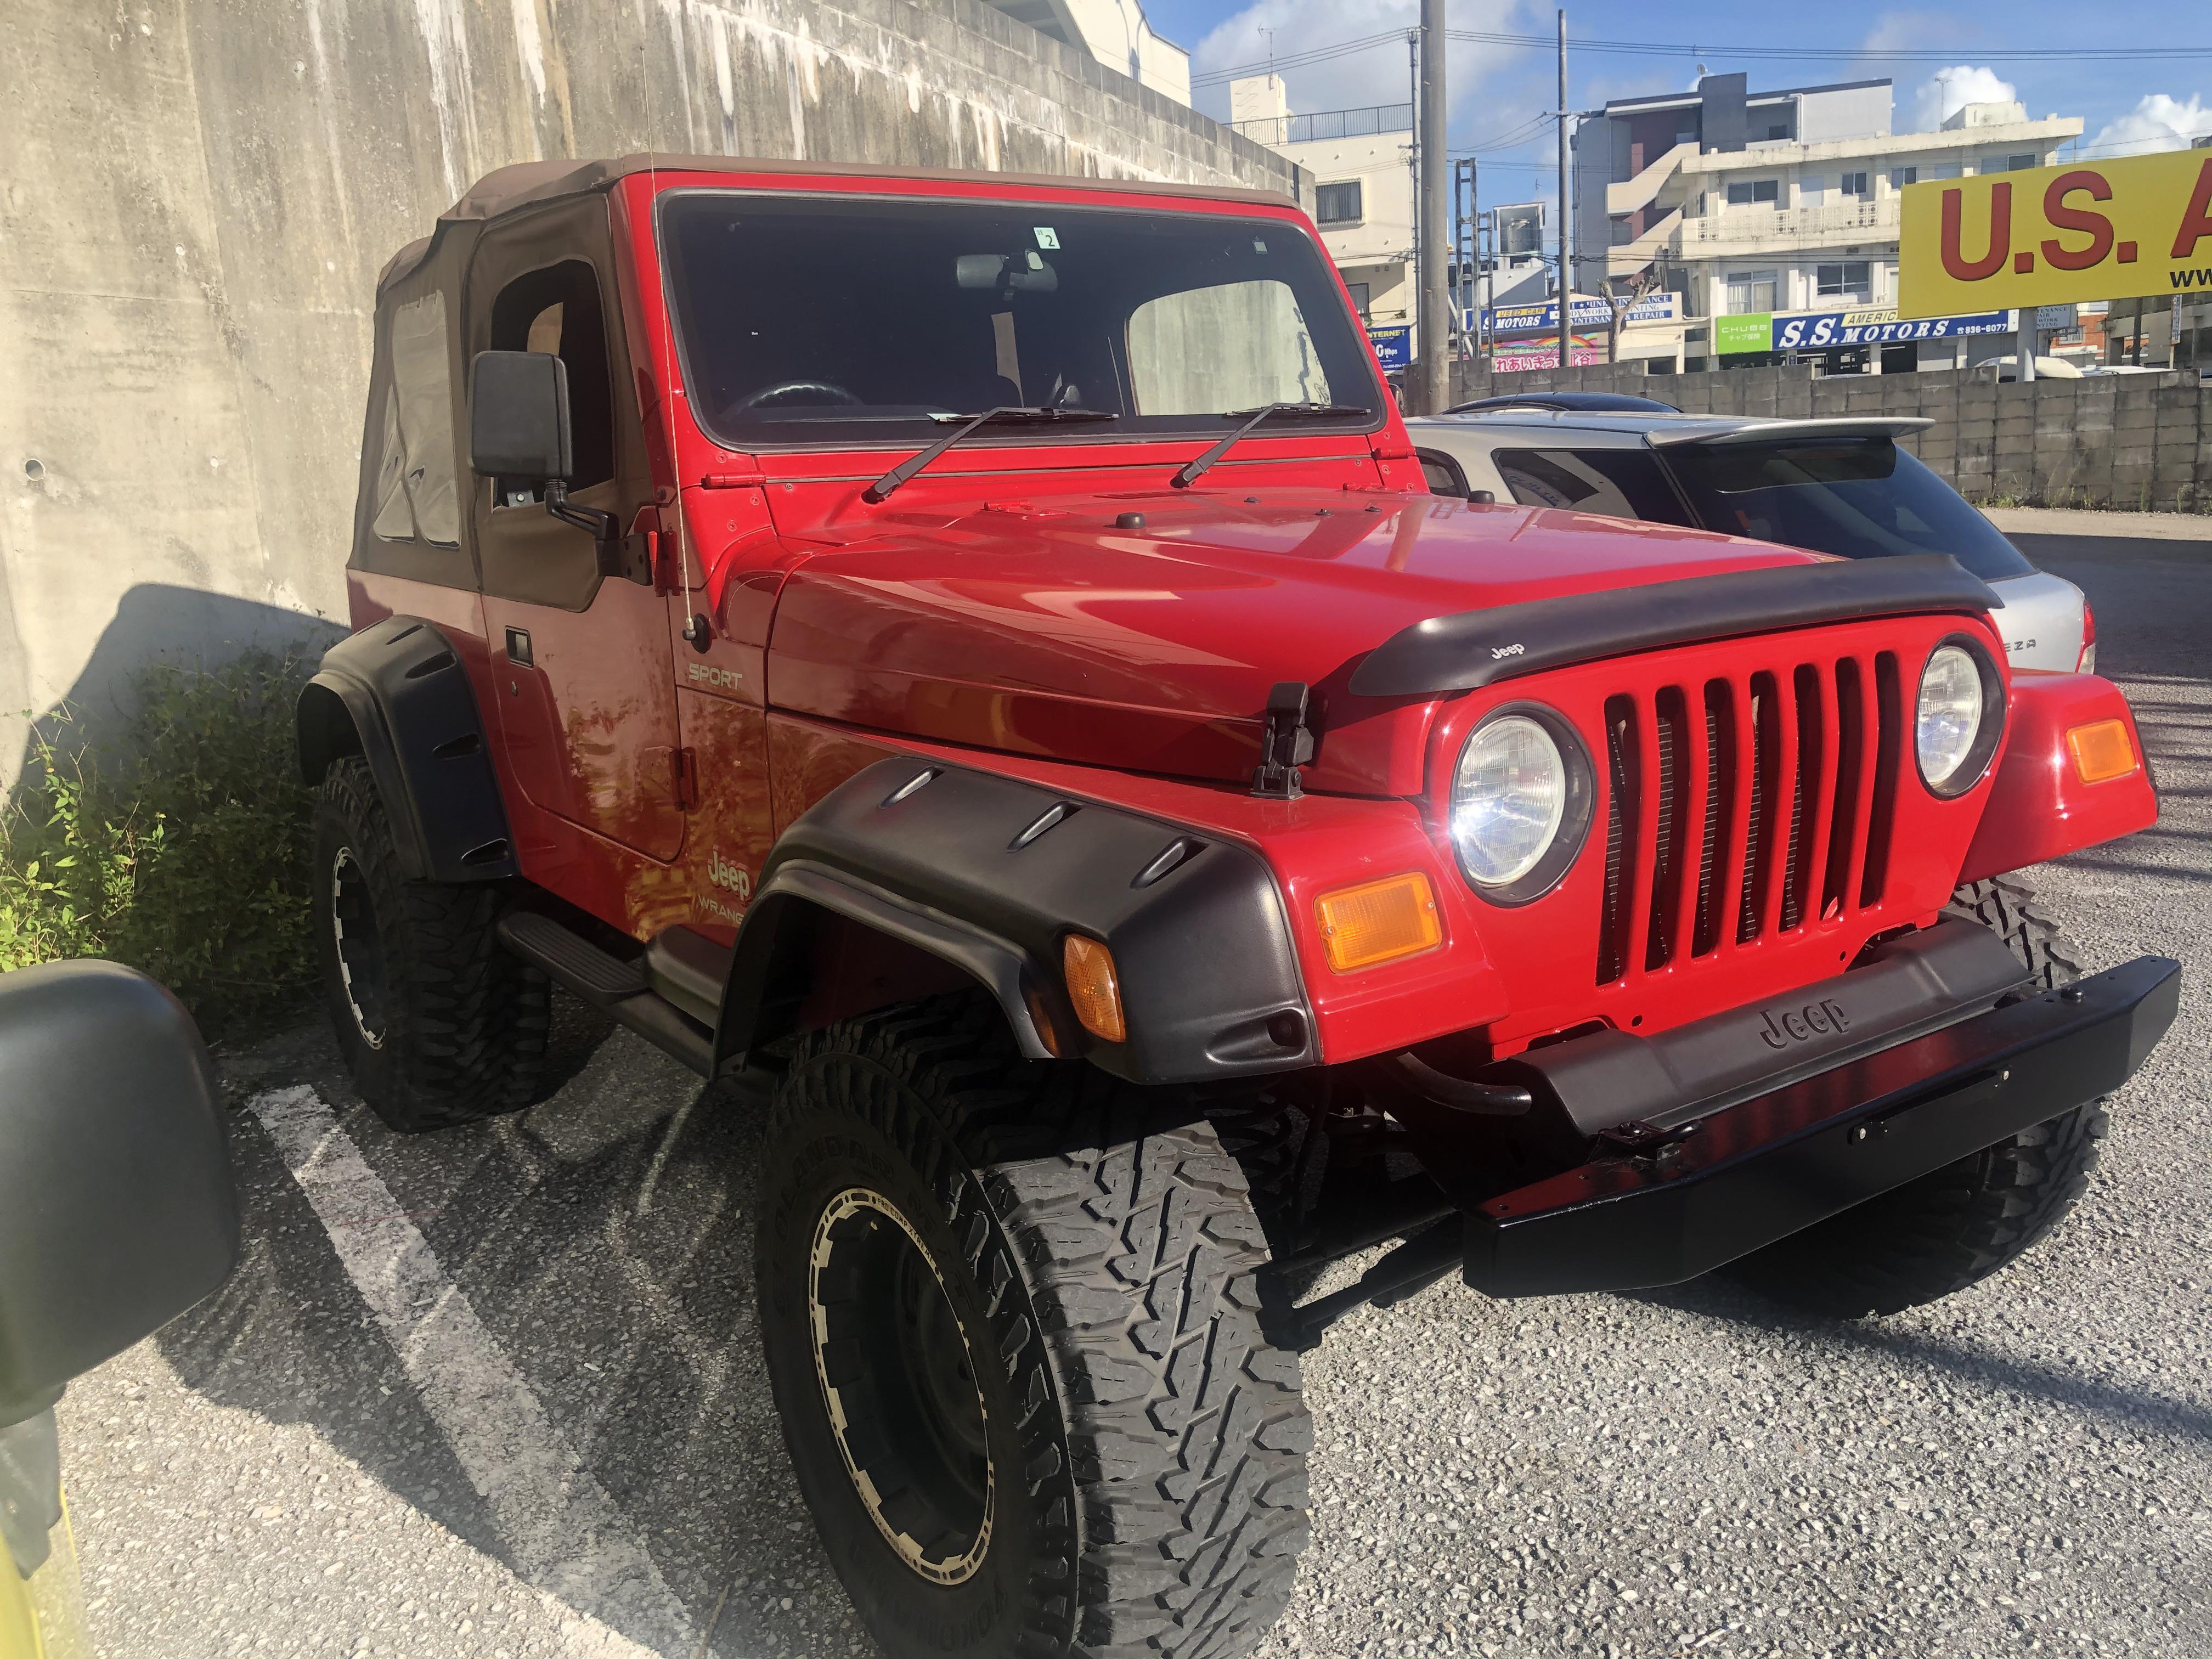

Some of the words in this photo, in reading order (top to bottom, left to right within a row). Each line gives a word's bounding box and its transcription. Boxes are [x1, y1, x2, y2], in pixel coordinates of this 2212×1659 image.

[1941, 170, 2138, 282] U.S.
[1045, 234, 1056, 247] 2
[1585, 307, 1610, 315] WORK
[1633, 311, 1665, 320] REPAIR
[1495, 315, 1542, 329] MOTORS
[1722, 324, 1768, 334] CHUBB
[1729, 332, 1760, 342] チャブ保険
[1778, 318, 1838, 348] S.S.
[1841, 320, 1950, 343] MOTORS
[1491, 643, 1525, 659] Jeep
[689, 663, 742, 690] SPORT
[707, 850, 750, 901] Jeep
[1759, 998, 1850, 1049] Jeep
[878, 1198, 889, 1211] PRO
[890, 1207, 908, 1227] COMP
